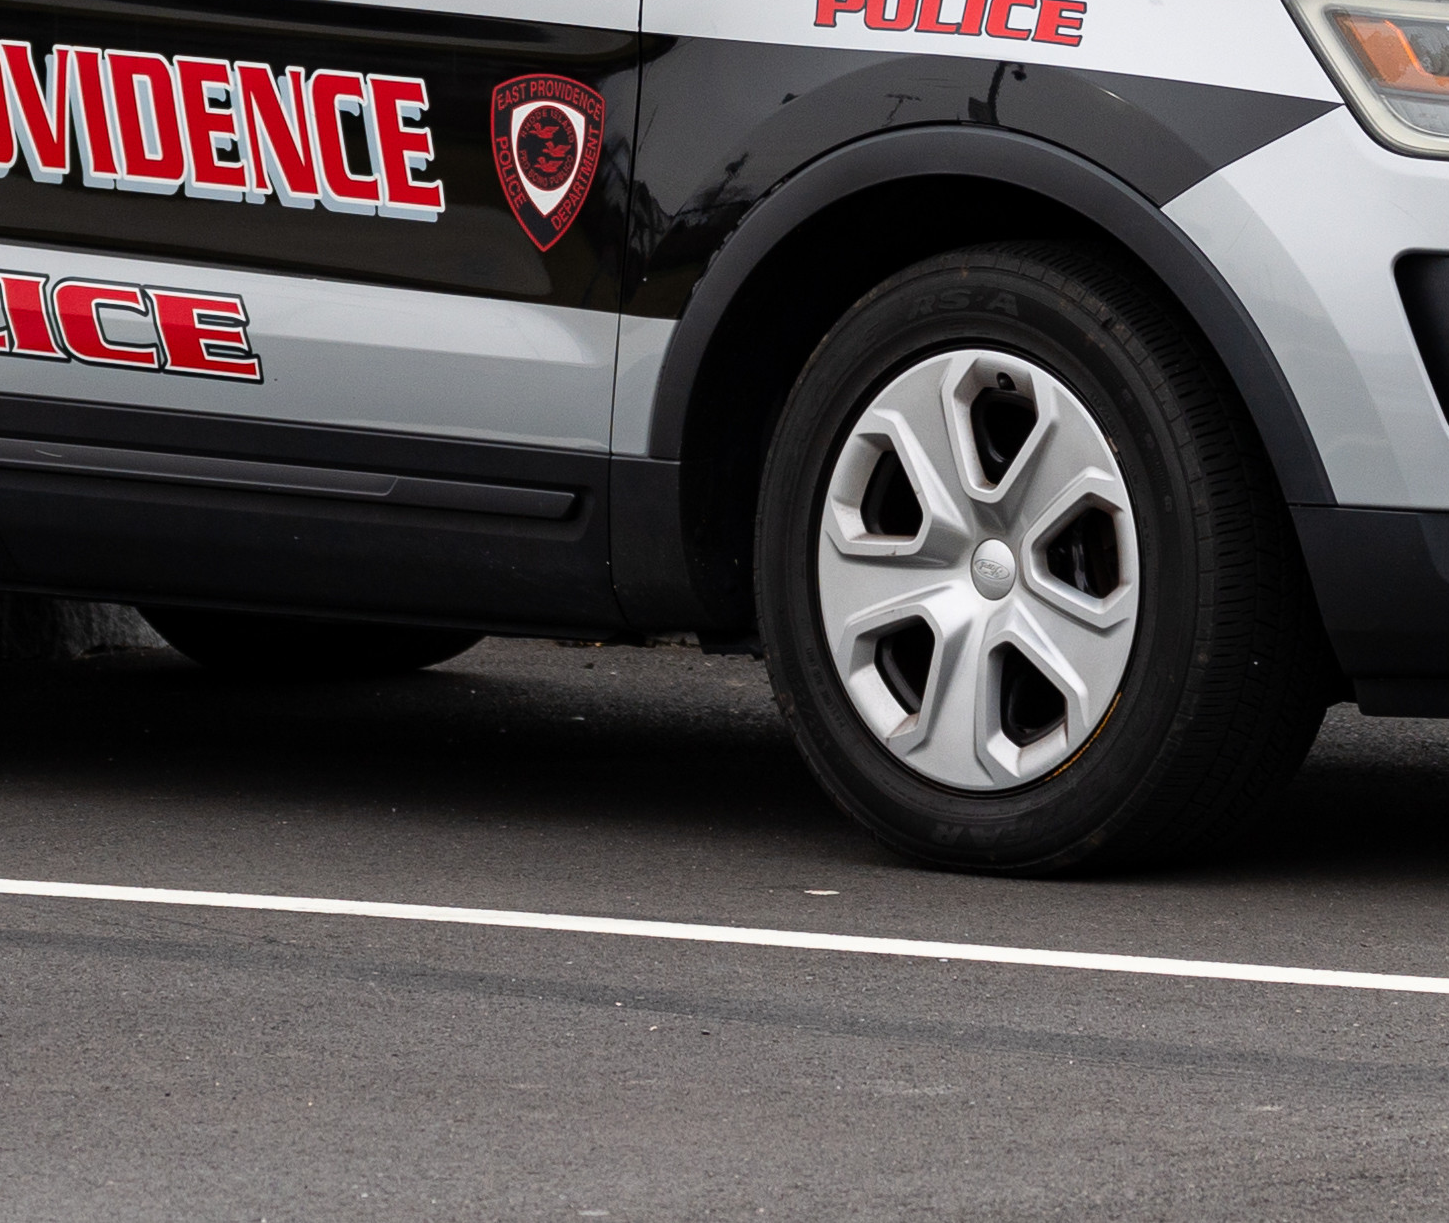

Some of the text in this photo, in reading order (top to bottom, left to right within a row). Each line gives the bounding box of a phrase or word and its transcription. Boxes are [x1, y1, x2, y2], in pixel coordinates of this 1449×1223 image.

[496, 79, 603, 121] EAST PROVIDENCE
[495, 126, 601, 232] POLICE DEPARTMENT
